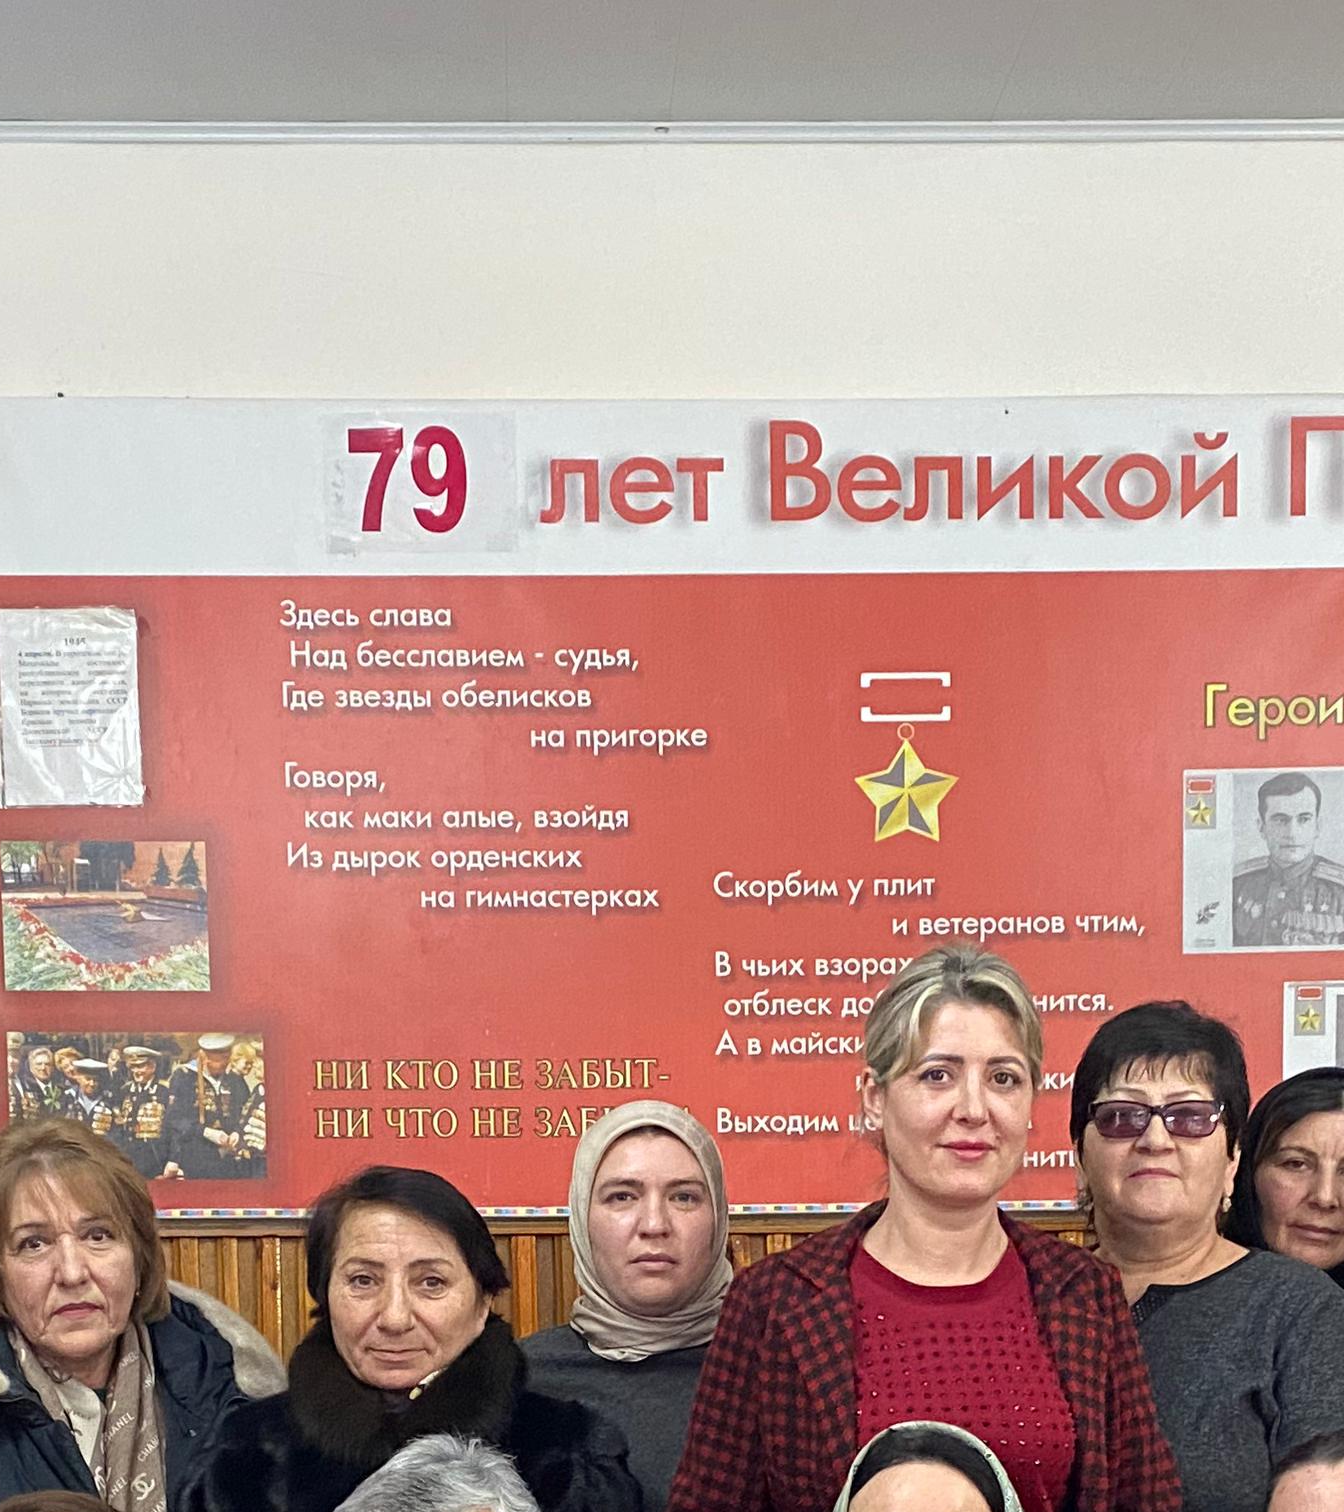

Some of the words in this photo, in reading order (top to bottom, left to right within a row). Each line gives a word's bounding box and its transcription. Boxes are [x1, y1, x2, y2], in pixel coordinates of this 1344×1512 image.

[348, 425, 467, 534] 79
[540, 457, 724, 524] лет
[770, 421, 1237, 523] Великой
[279, 599, 360, 631] Здесь
[369, 608, 452, 627] слава
[289, 639, 348, 671] Над
[356, 639, 525, 668] бесславием
[554, 648, 639, 676] судья,
[282, 680, 325, 712] Где
[334, 689, 432, 711] звезды
[441, 679, 592, 708] обелисков
[1206, 683, 1344, 740] Герои
[530, 729, 565, 748] на
[575, 728, 708, 756] пригорке
[284, 761, 386, 797] Говоря,
[304, 810, 355, 829] как
[363, 810, 432, 829] маки
[442, 810, 523, 833] алые,
[534, 804, 629, 831] взойдя
[286, 841, 324, 869] Из
[331, 850, 422, 877] дырок
[430, 849, 583, 877] орденских
[420, 890, 455, 908] на
[465, 889, 659, 916] гимнастерках
[713, 869, 839, 906] Скорбим
[847, 878, 864, 906] у
[873, 878, 936, 897] плит
[892, 918, 908, 936] и
[919, 915, 1066, 943] ветеранов
[1075, 915, 1146, 937] чтим,
[715, 950, 732, 977] В
[741, 958, 805, 977] чьих
[723, 988, 832, 1016] отблеск
[1032, 993, 1114, 1012] нится.
[715, 1029, 739, 1056] А
[747, 1037, 762, 1056] в
[313, 1059, 370, 1092] НИ
[383, 1058, 460, 1092] КТО
[471, 1058, 524, 1091] НЕ
[538, 1057, 671, 1091] ЗАБЫТ-
[315, 1107, 371, 1140] НИ
[383, 1106, 459, 1139] ЧТО
[470, 1106, 522, 1139] НЕ
[536, 1105, 613, 1139] ЗАБ
[717, 1107, 839, 1136] Выходим
